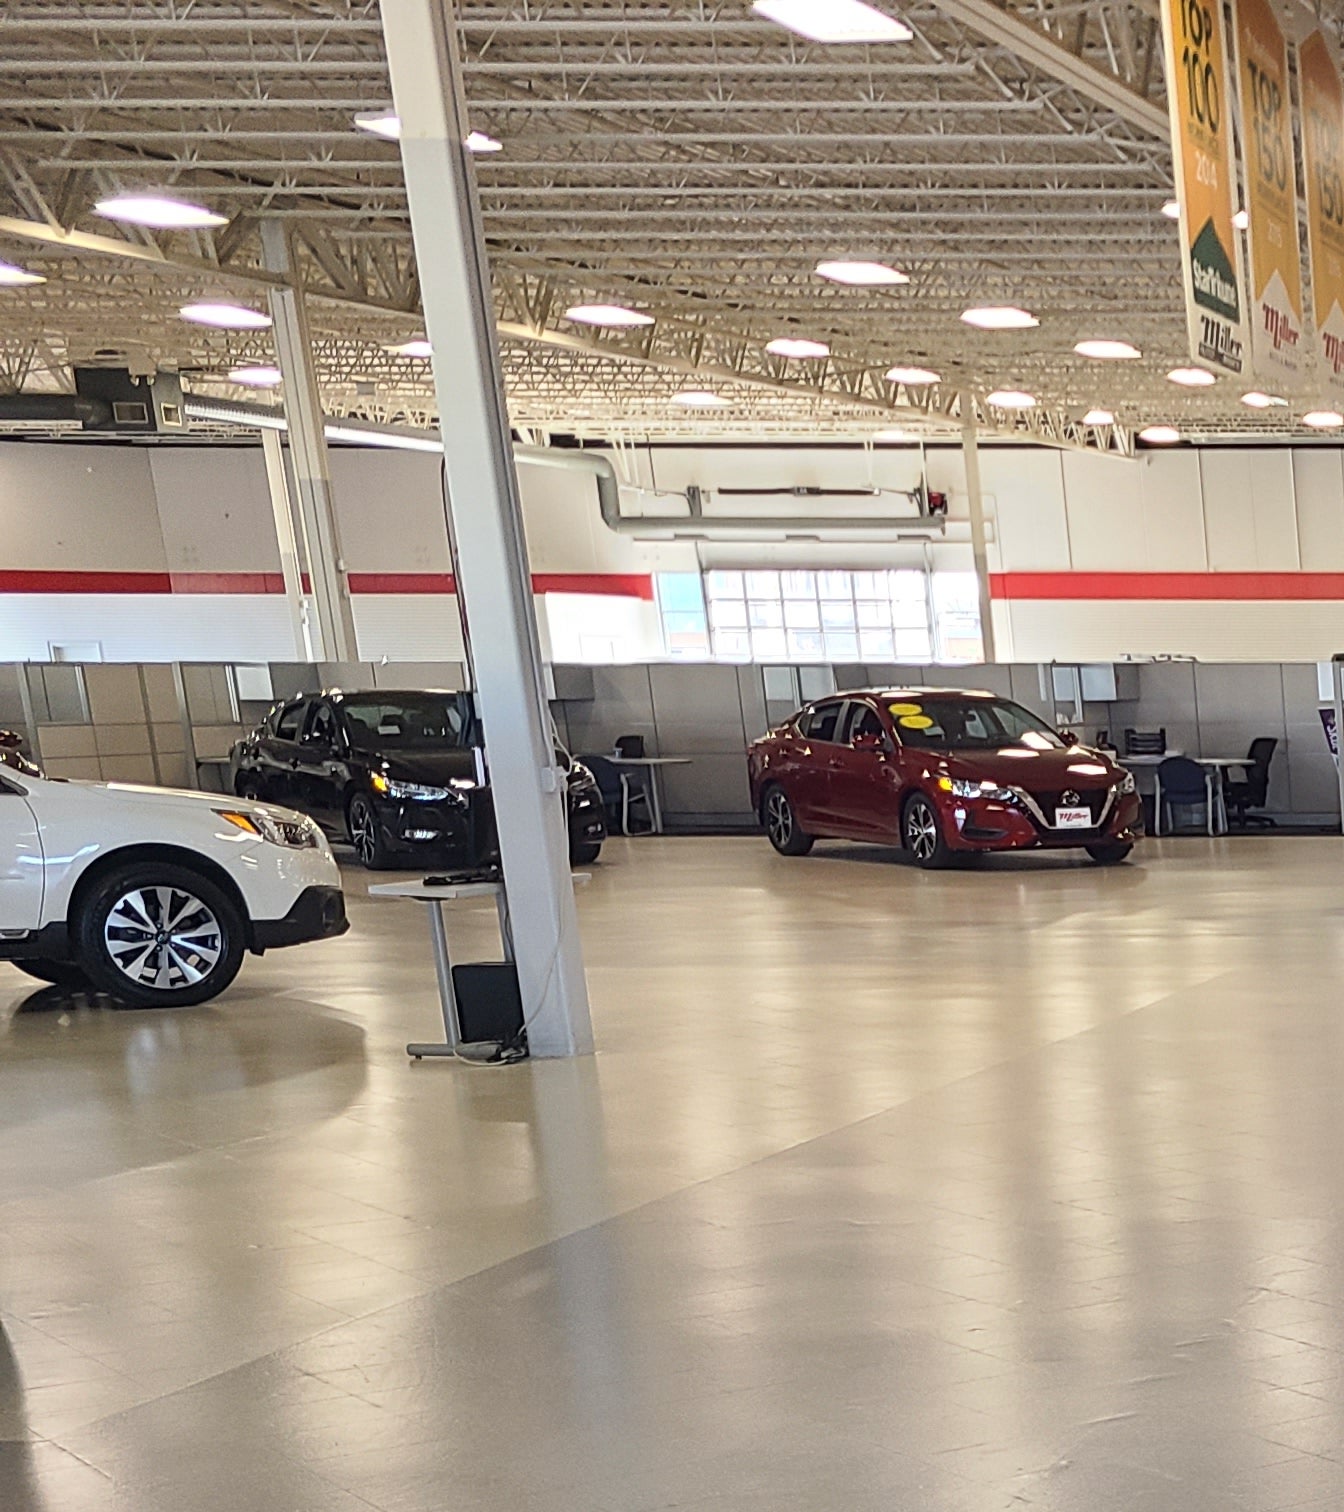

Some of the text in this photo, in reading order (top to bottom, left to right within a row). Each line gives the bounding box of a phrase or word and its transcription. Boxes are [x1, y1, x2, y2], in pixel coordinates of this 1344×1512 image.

[1183, 45, 1221, 135] 100
[1247, 58, 1282, 127] TOP
[1253, 115, 1287, 191] 150
[1201, 314, 1243, 358] Miller
[1262, 302, 1299, 350] Miller
